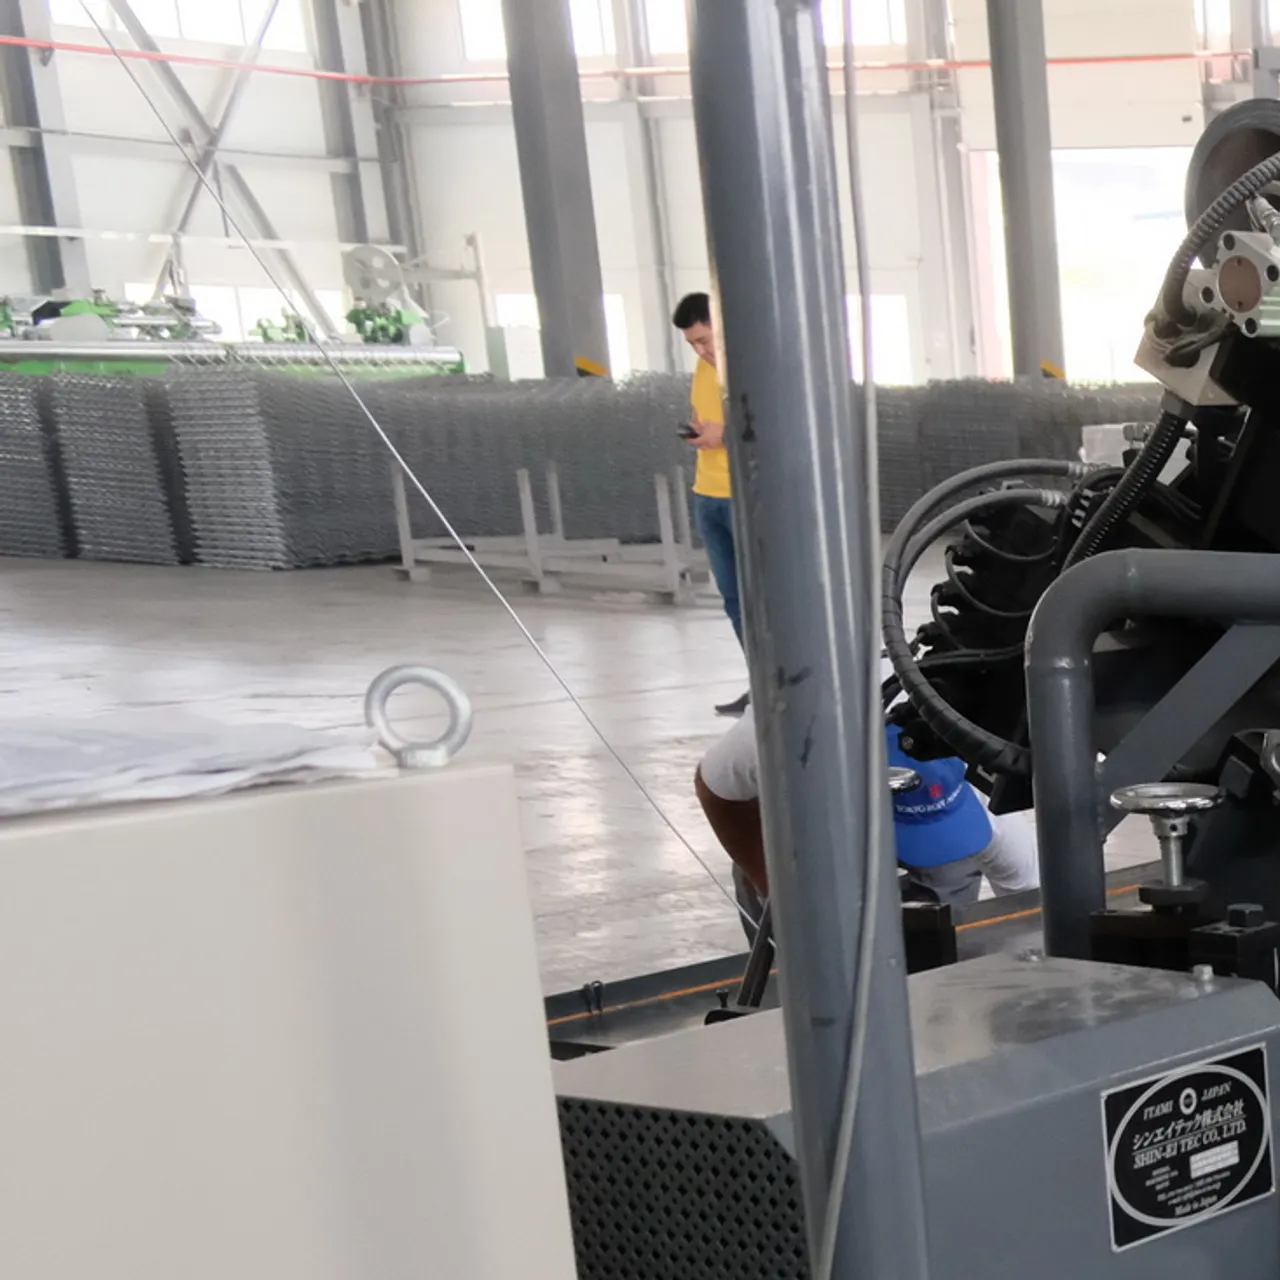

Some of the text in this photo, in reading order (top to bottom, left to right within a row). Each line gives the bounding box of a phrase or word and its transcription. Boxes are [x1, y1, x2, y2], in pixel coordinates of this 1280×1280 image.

[1132, 1098, 1244, 1150] シンエイテック株式会社
[1143, 1100, 1174, 1120] ITAMI
[1133, 1142, 1178, 1168] SHIN-EI
[1180, 1133, 1202, 1152] TEC
